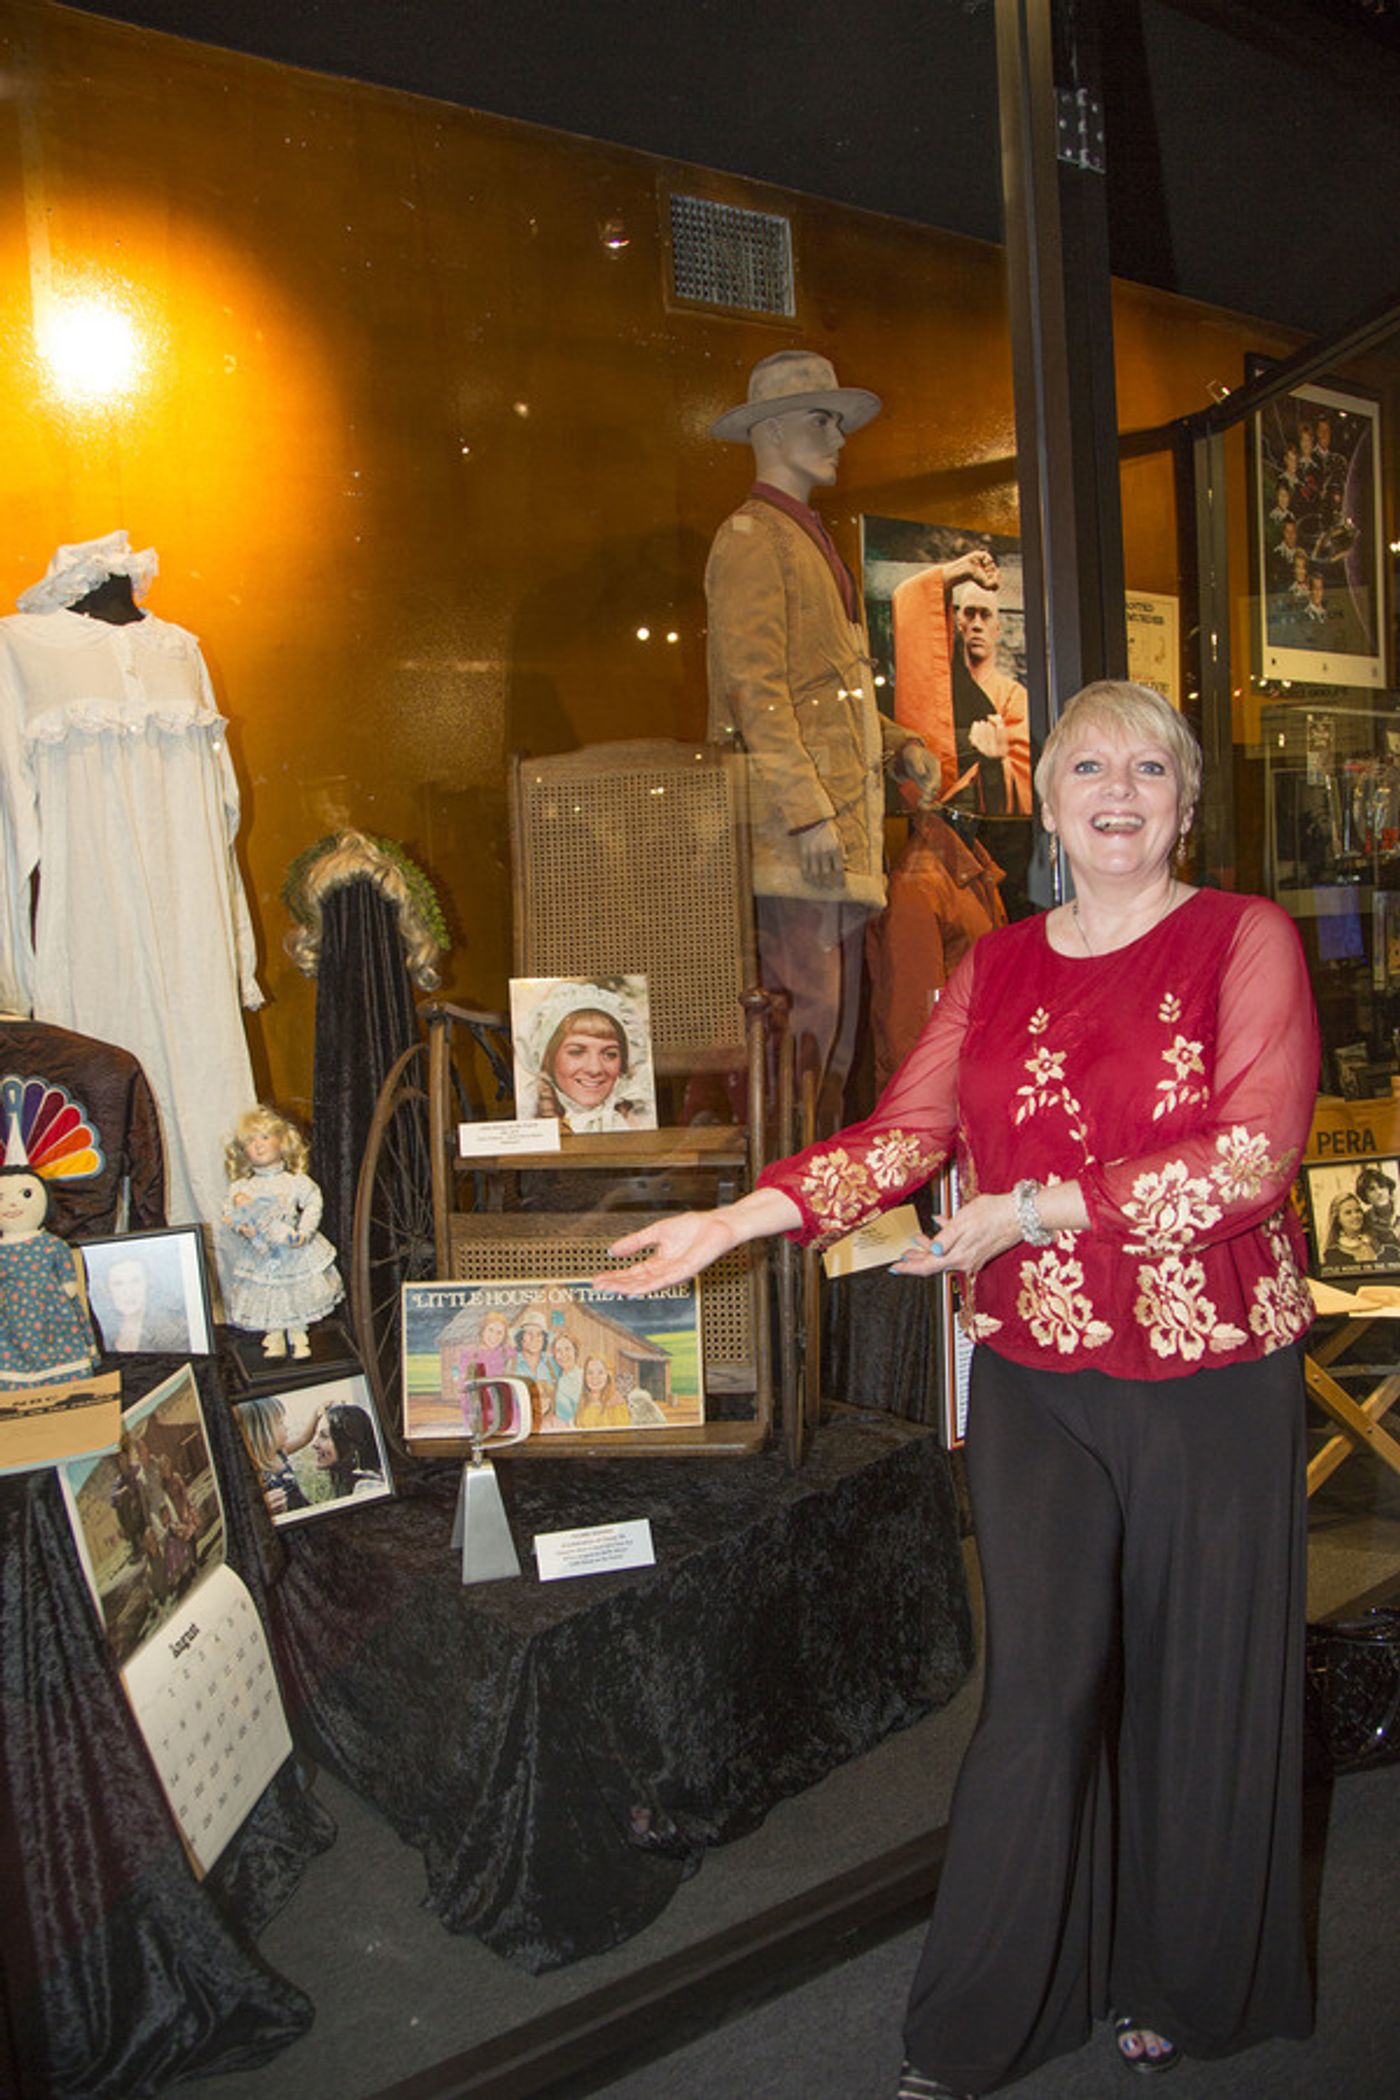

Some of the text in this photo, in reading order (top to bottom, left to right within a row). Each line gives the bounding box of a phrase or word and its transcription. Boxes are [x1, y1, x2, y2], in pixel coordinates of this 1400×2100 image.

[1316, 1127, 1377, 1156] PERA
[411, 1290, 482, 1309] LITTLE
[483, 1288, 547, 1306] HOUSE
[548, 1286, 574, 1303] ON
[168, 1622, 201, 1660] August
